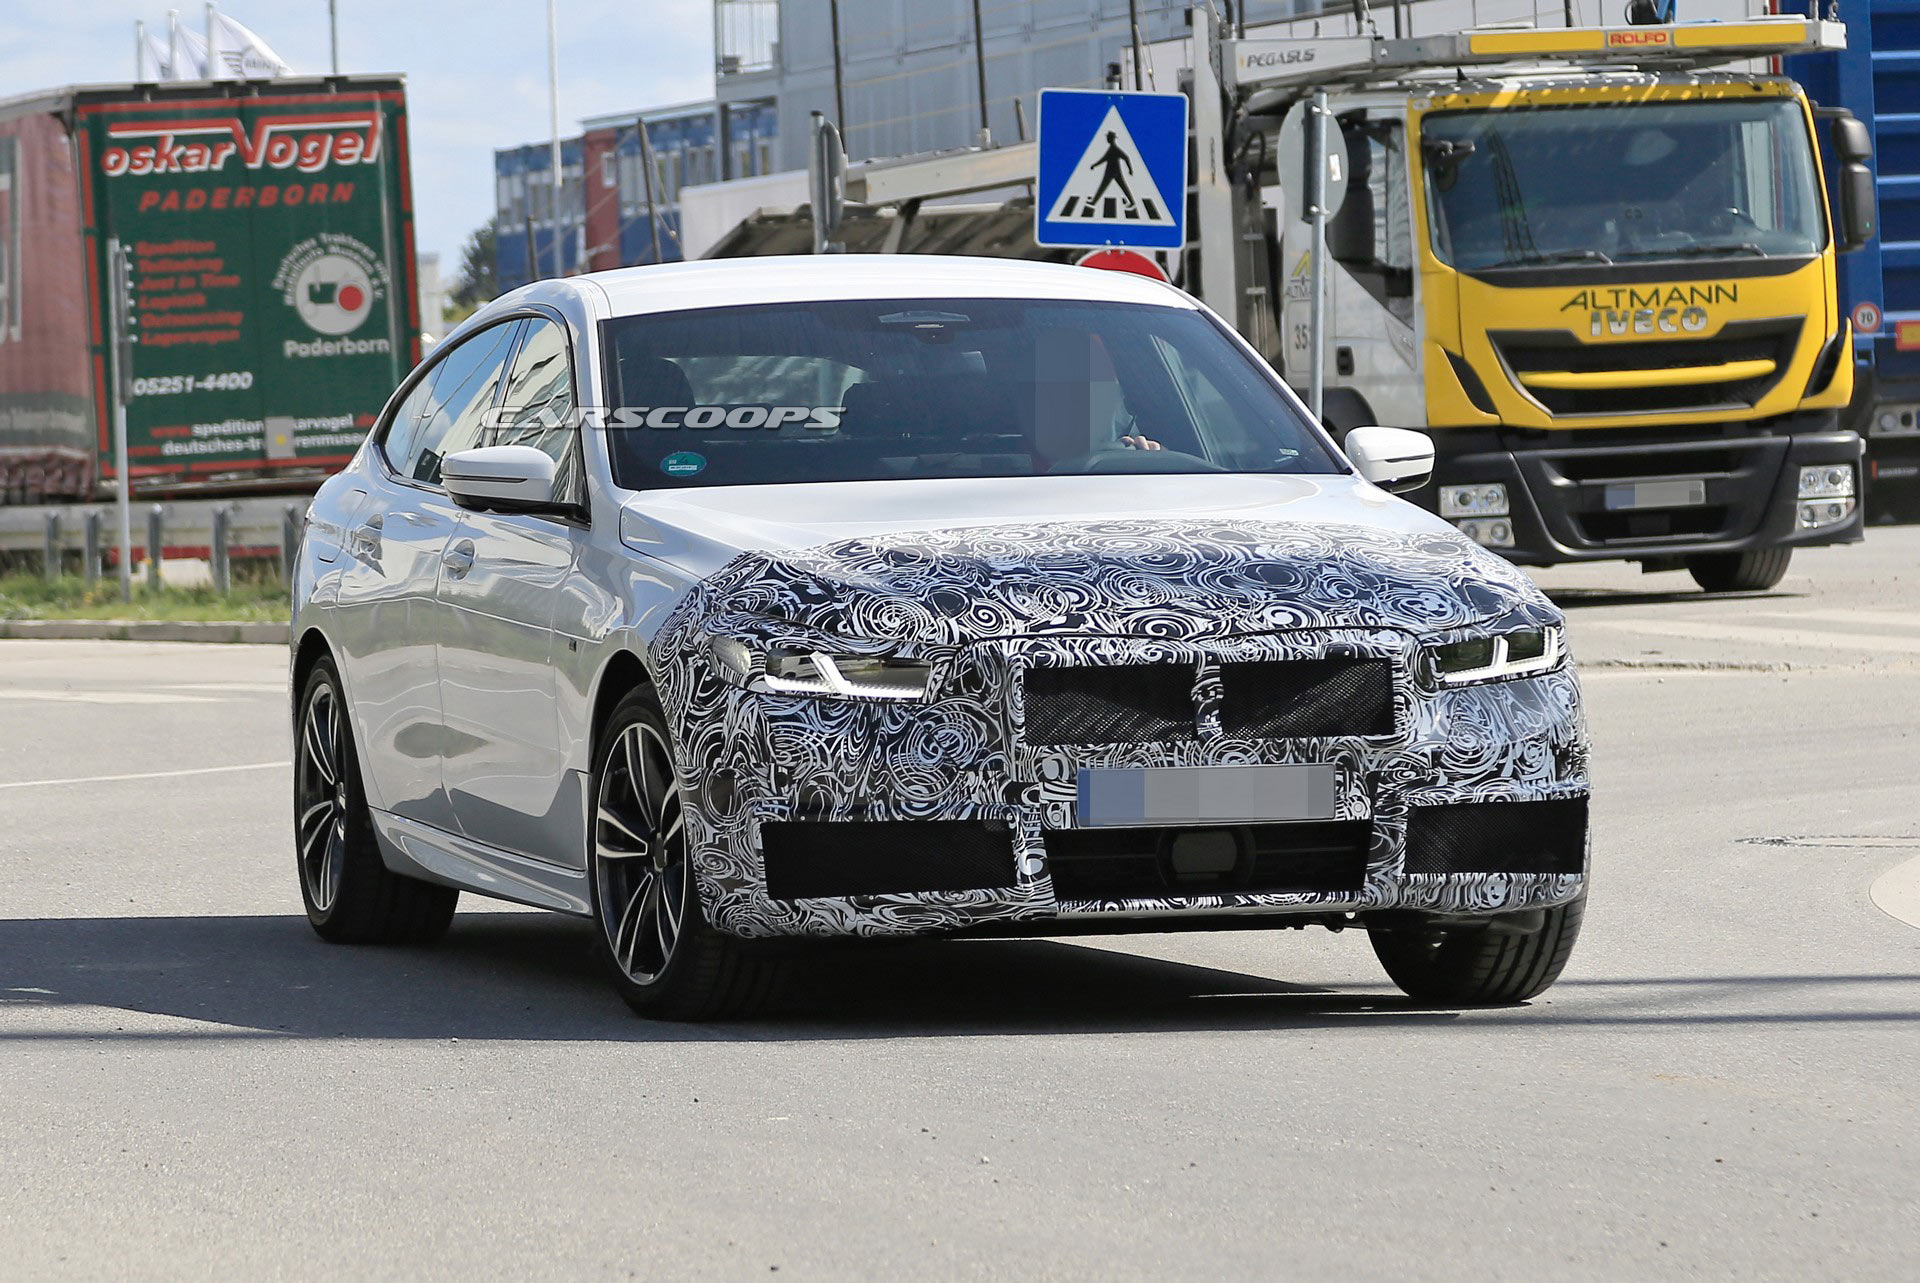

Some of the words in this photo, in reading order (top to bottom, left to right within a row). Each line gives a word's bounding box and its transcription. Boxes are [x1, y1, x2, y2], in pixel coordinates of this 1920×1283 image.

[1610, 32, 1667, 46] ROLFO
[1246, 48, 1317, 68] PEGASUS
[230, 112, 382, 173] Vogel
[138, 182, 356, 213] PADERBORN
[1560, 283, 1738, 312] ALTMANN
[1590, 305, 1708, 337] IVECO
[283, 336, 389, 358] Paderborn
[133, 371, 253, 396] 05251-4400
